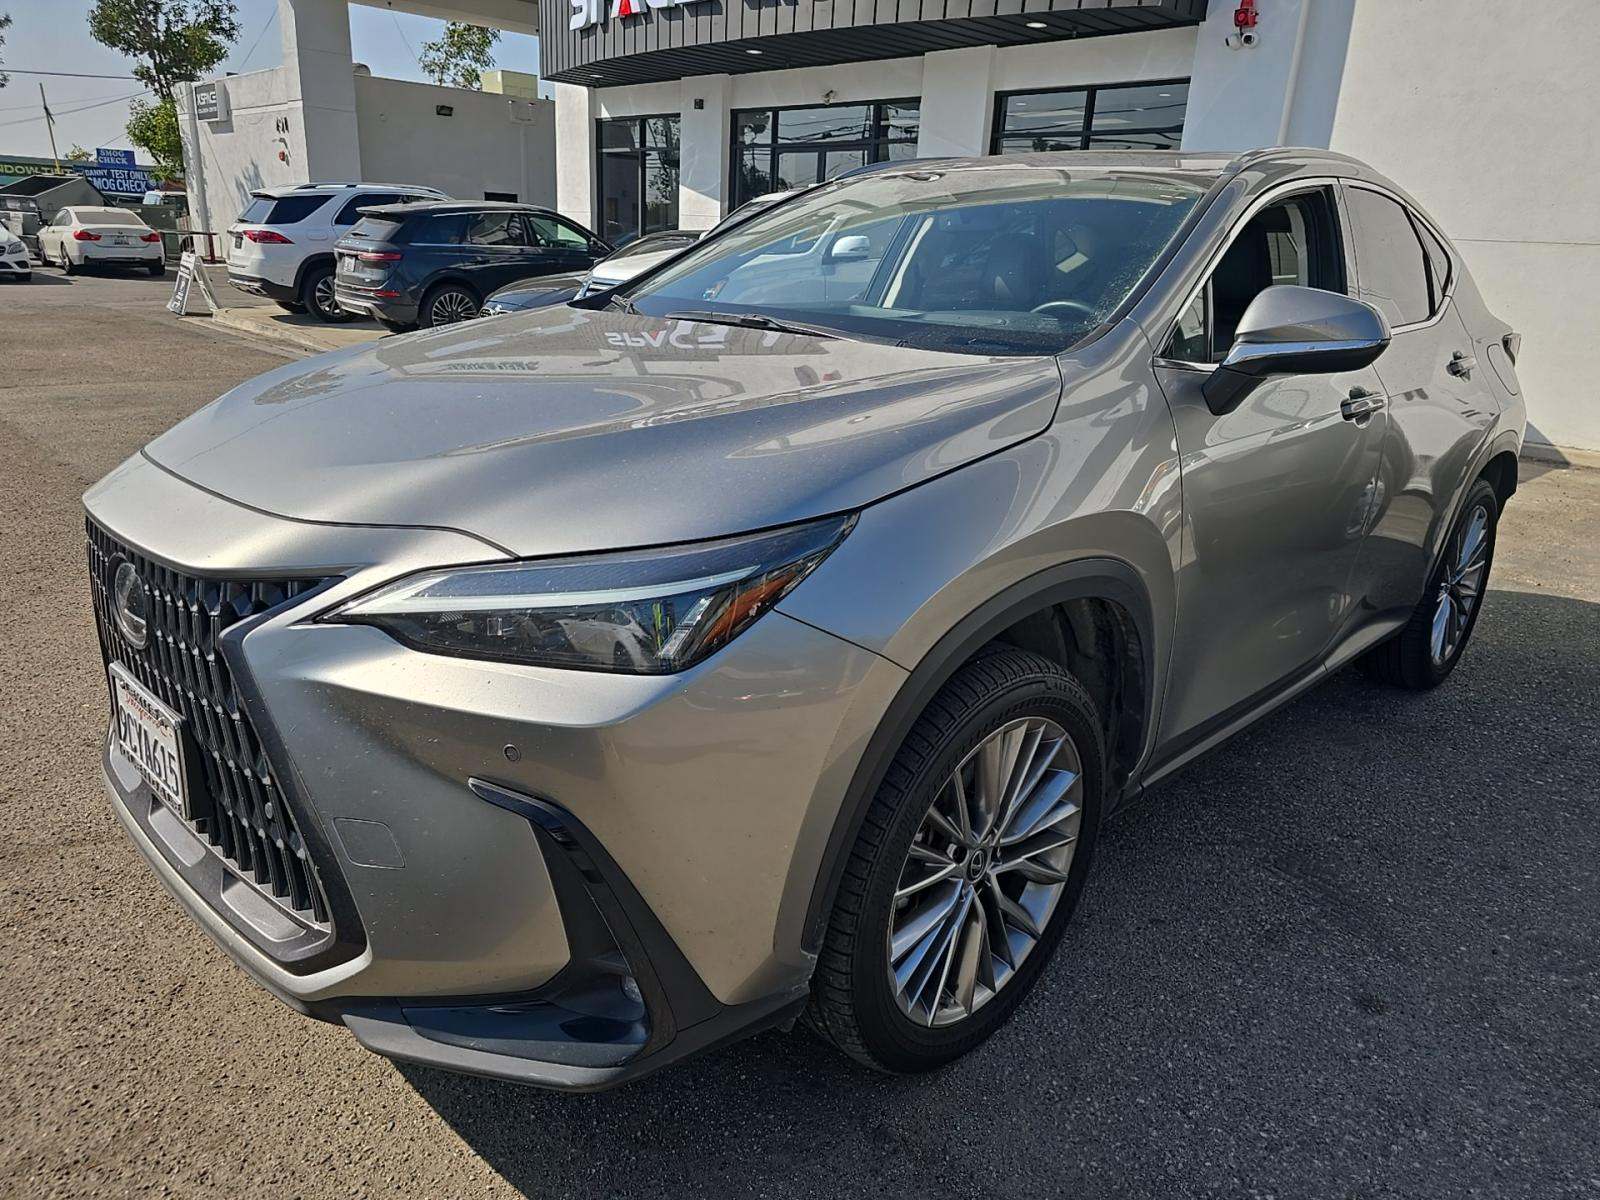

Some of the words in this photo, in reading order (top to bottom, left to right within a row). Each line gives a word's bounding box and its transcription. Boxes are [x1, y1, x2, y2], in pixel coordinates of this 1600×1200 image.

[100, 150, 124, 158] SMOG
[98, 157, 128, 165] CHECK
[110, 169, 129, 180] TEST
[129, 170, 150, 181] ONLY
[116, 179, 147, 192] CHECK
[118, 704, 180, 797] 9CYA615
